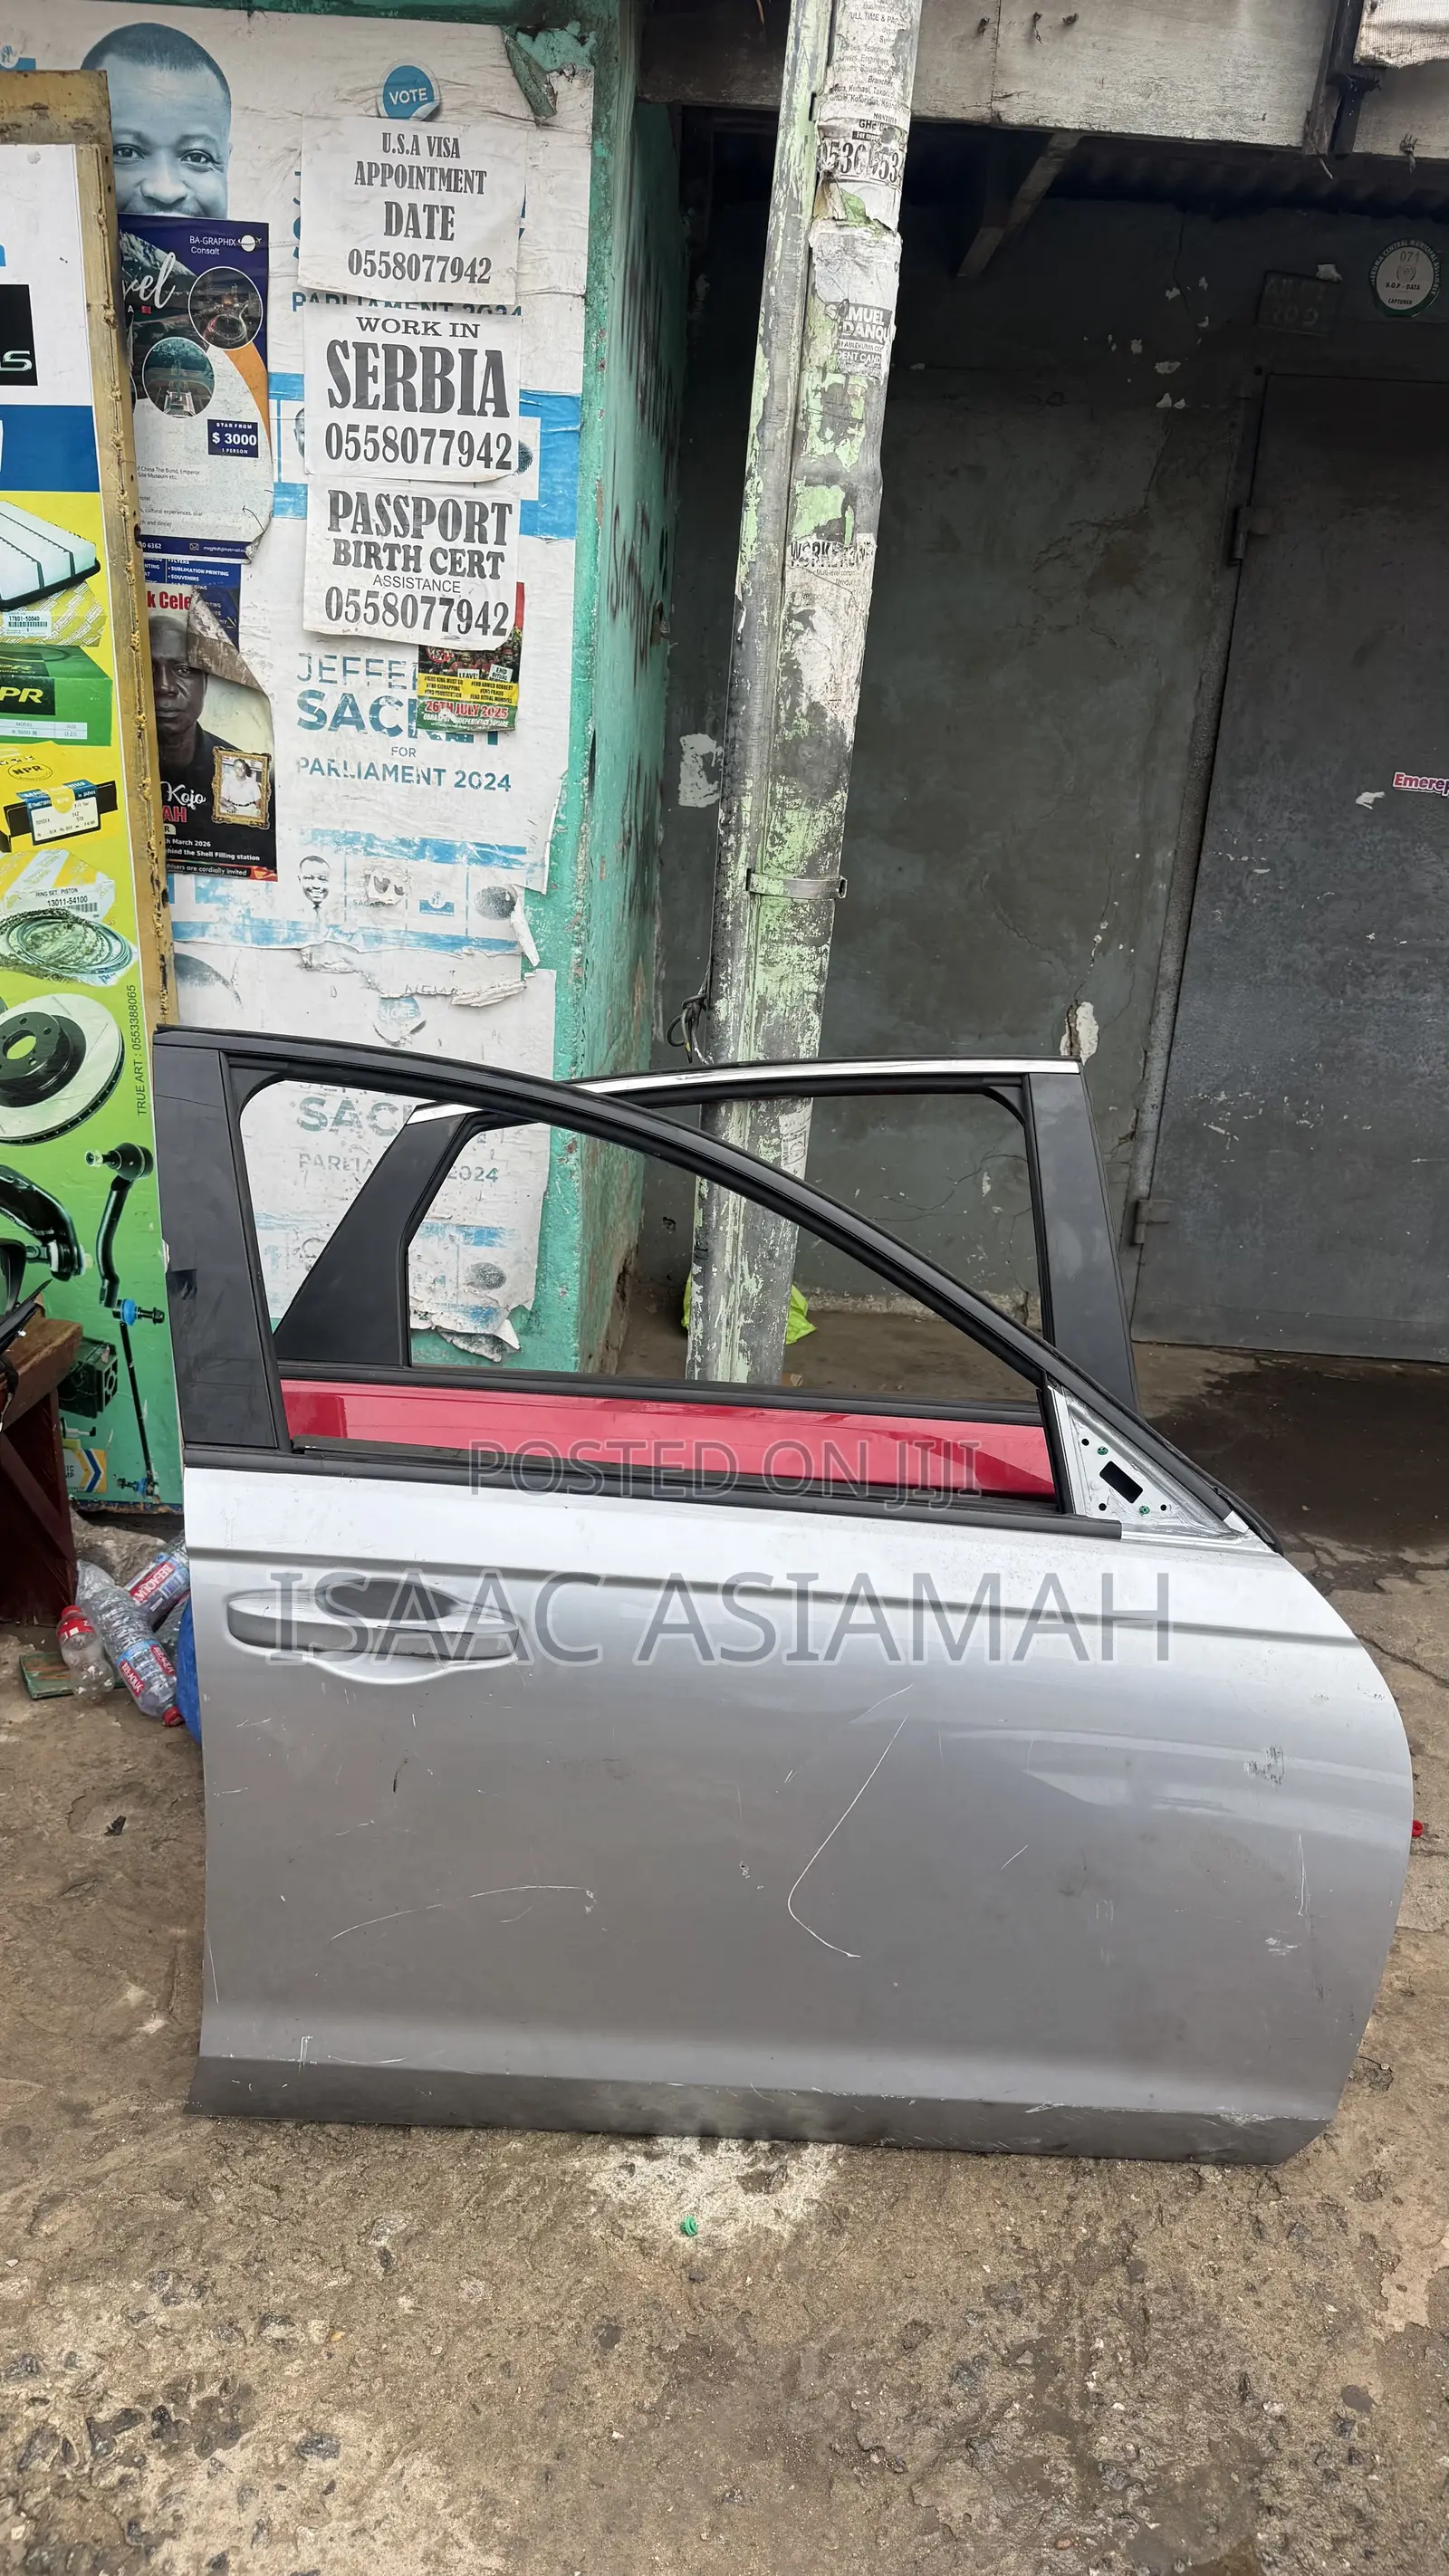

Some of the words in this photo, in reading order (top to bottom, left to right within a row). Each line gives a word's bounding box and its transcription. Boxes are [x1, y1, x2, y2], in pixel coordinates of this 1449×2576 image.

[389, 88, 427, 105] VOTE
[382, 132, 420, 156] U.S.A
[427, 135, 460, 158] VISA
[354, 161, 487, 195] APPOINTMENT
[384, 201, 455, 242] DATE
[189, 235, 236, 247] BA-GRAPHIX
[348, 248, 492, 284] 0558077942
[825, 303, 885, 325] SMUEL
[356, 316, 442, 337] WORK
[449, 322, 481, 339] IN
[326, 339, 510, 417] SERBIA
[225, 433, 257, 445] 3000
[325, 423, 512, 470] 0558077942
[180, 468, 200, 476] Emperor
[327, 489, 513, 547] PASSPORT
[332, 538, 423, 573] BIRTH
[429, 547, 504, 579] CERT
[373, 574, 461, 594] ASSISTANCE
[325, 587, 509, 637] 0558077942
[296, 652, 417, 691] JEFFE
[456, 703, 479, 716] JULY
[481, 705, 509, 718] 2025
[391, 746, 417, 758] FOR
[12, 765, 43, 776] NPR
[297, 757, 446, 787] PARLIAMENT
[454, 770, 512, 792] 2024
[166, 783, 206, 811] Kojo
[194, 839, 212, 847] 2026
[215, 851, 235, 861] Filling
[236, 853, 261, 861] station
[198, 865, 226, 876] cordially
[226, 867, 248, 876] invited
[47, 895, 89, 906] 13011-54100
[126, 984, 143, 1051] 0553388065
[133, 1061, 146, 1083] ART
[135, 1084, 149, 1117] TRUE
